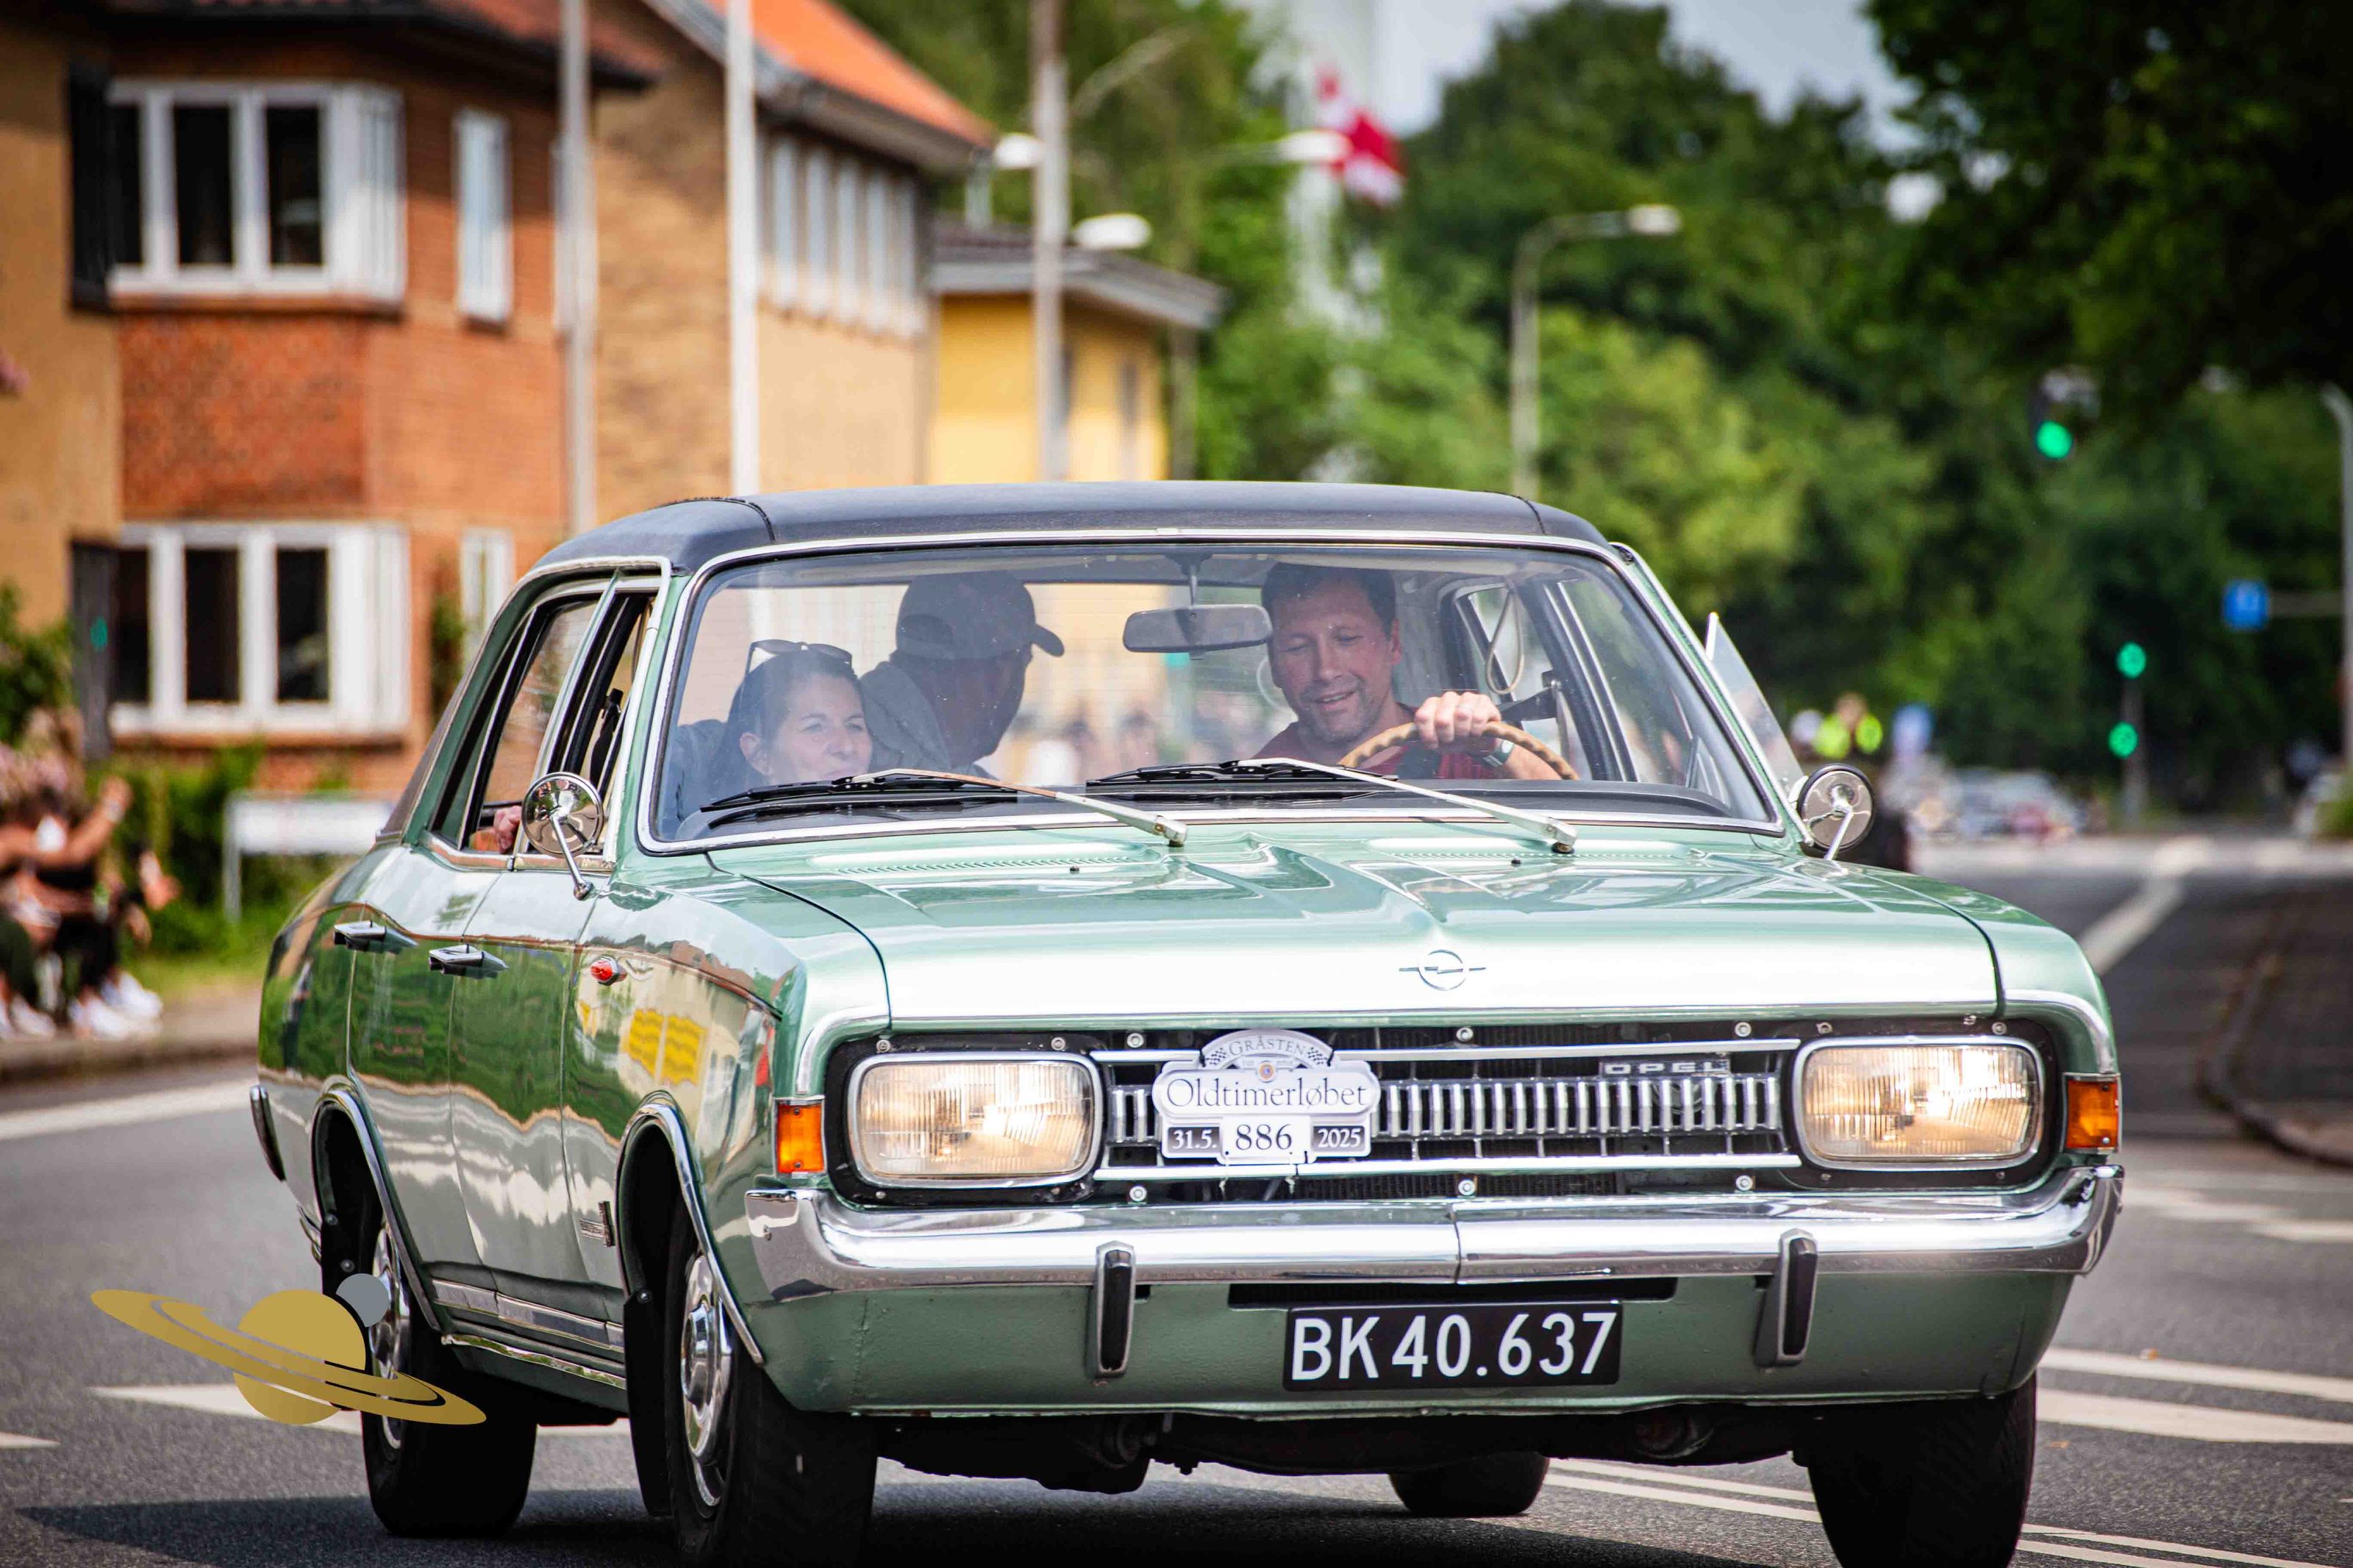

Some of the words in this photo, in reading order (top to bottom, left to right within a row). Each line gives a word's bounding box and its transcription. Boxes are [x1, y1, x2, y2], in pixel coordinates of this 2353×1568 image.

[1229, 1035, 1307, 1057] GRÅSTEN
[1604, 1062, 1728, 1075] OPEL
[1166, 1077, 1367, 1109] Oldtimerløbet
[1172, 1130, 1217, 1150] 31.5.
[1235, 1124, 1292, 1150] 886
[1317, 1128, 1361, 1148] 2025
[1291, 1316, 1380, 1381] BK
[1391, 1312, 1617, 1378] 40.637
